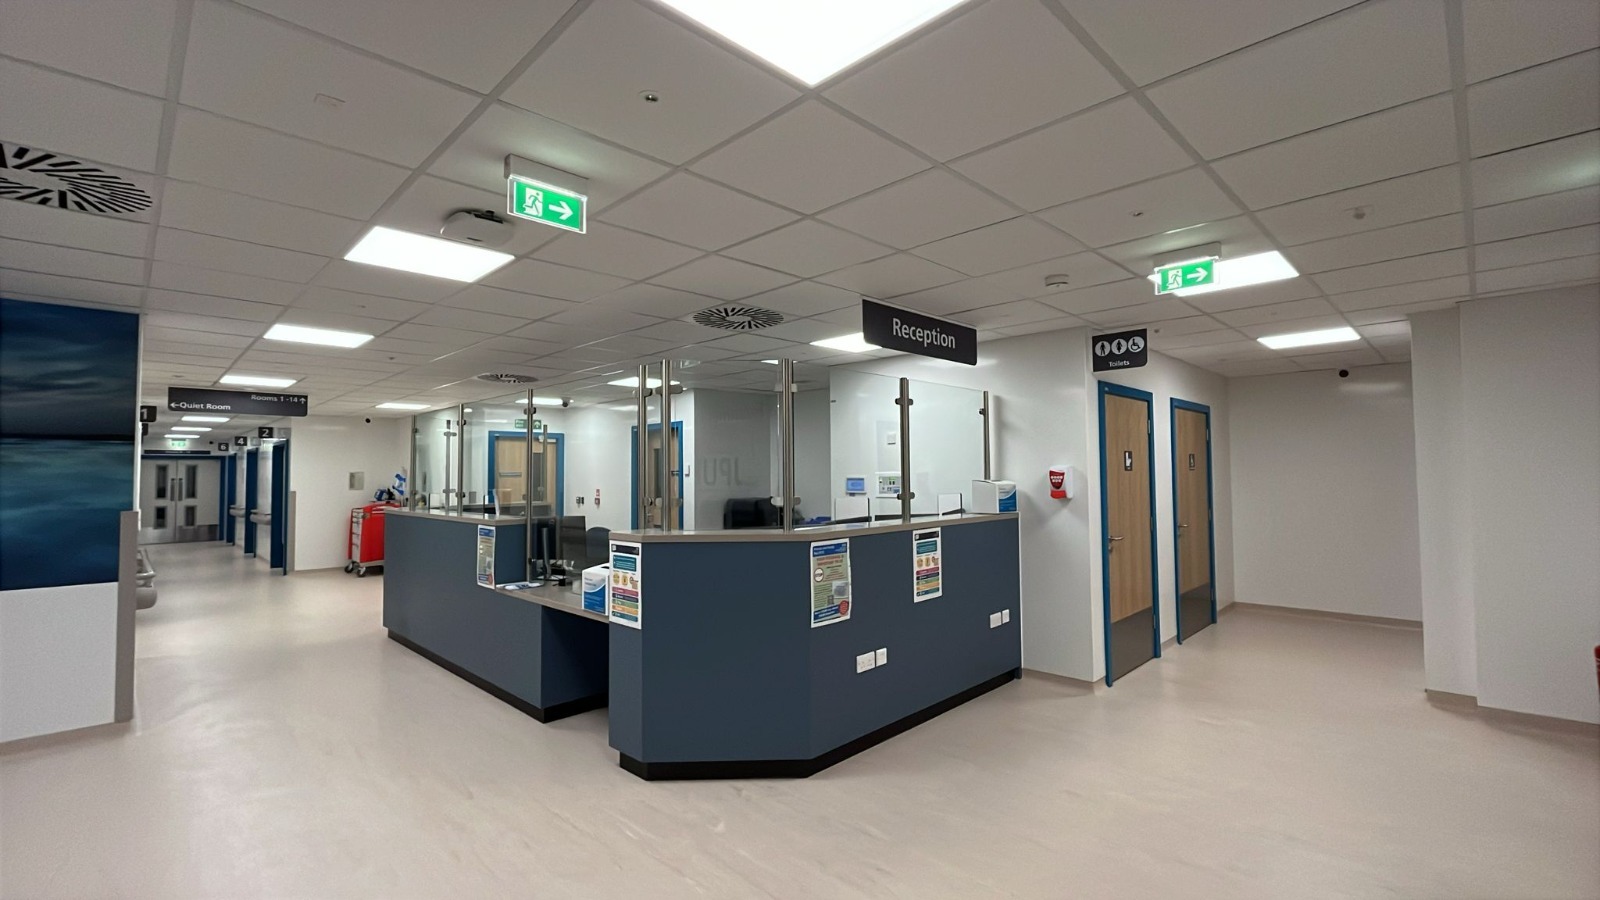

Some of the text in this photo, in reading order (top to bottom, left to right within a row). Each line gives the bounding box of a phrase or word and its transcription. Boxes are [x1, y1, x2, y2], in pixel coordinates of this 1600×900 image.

[892, 317, 956, 349] Reception
[251, 394, 278, 402] Rooms
[179, 401, 231, 411] Quiet Room
[262, 428, 270, 437] 2
[237, 437, 245, 445] 4
